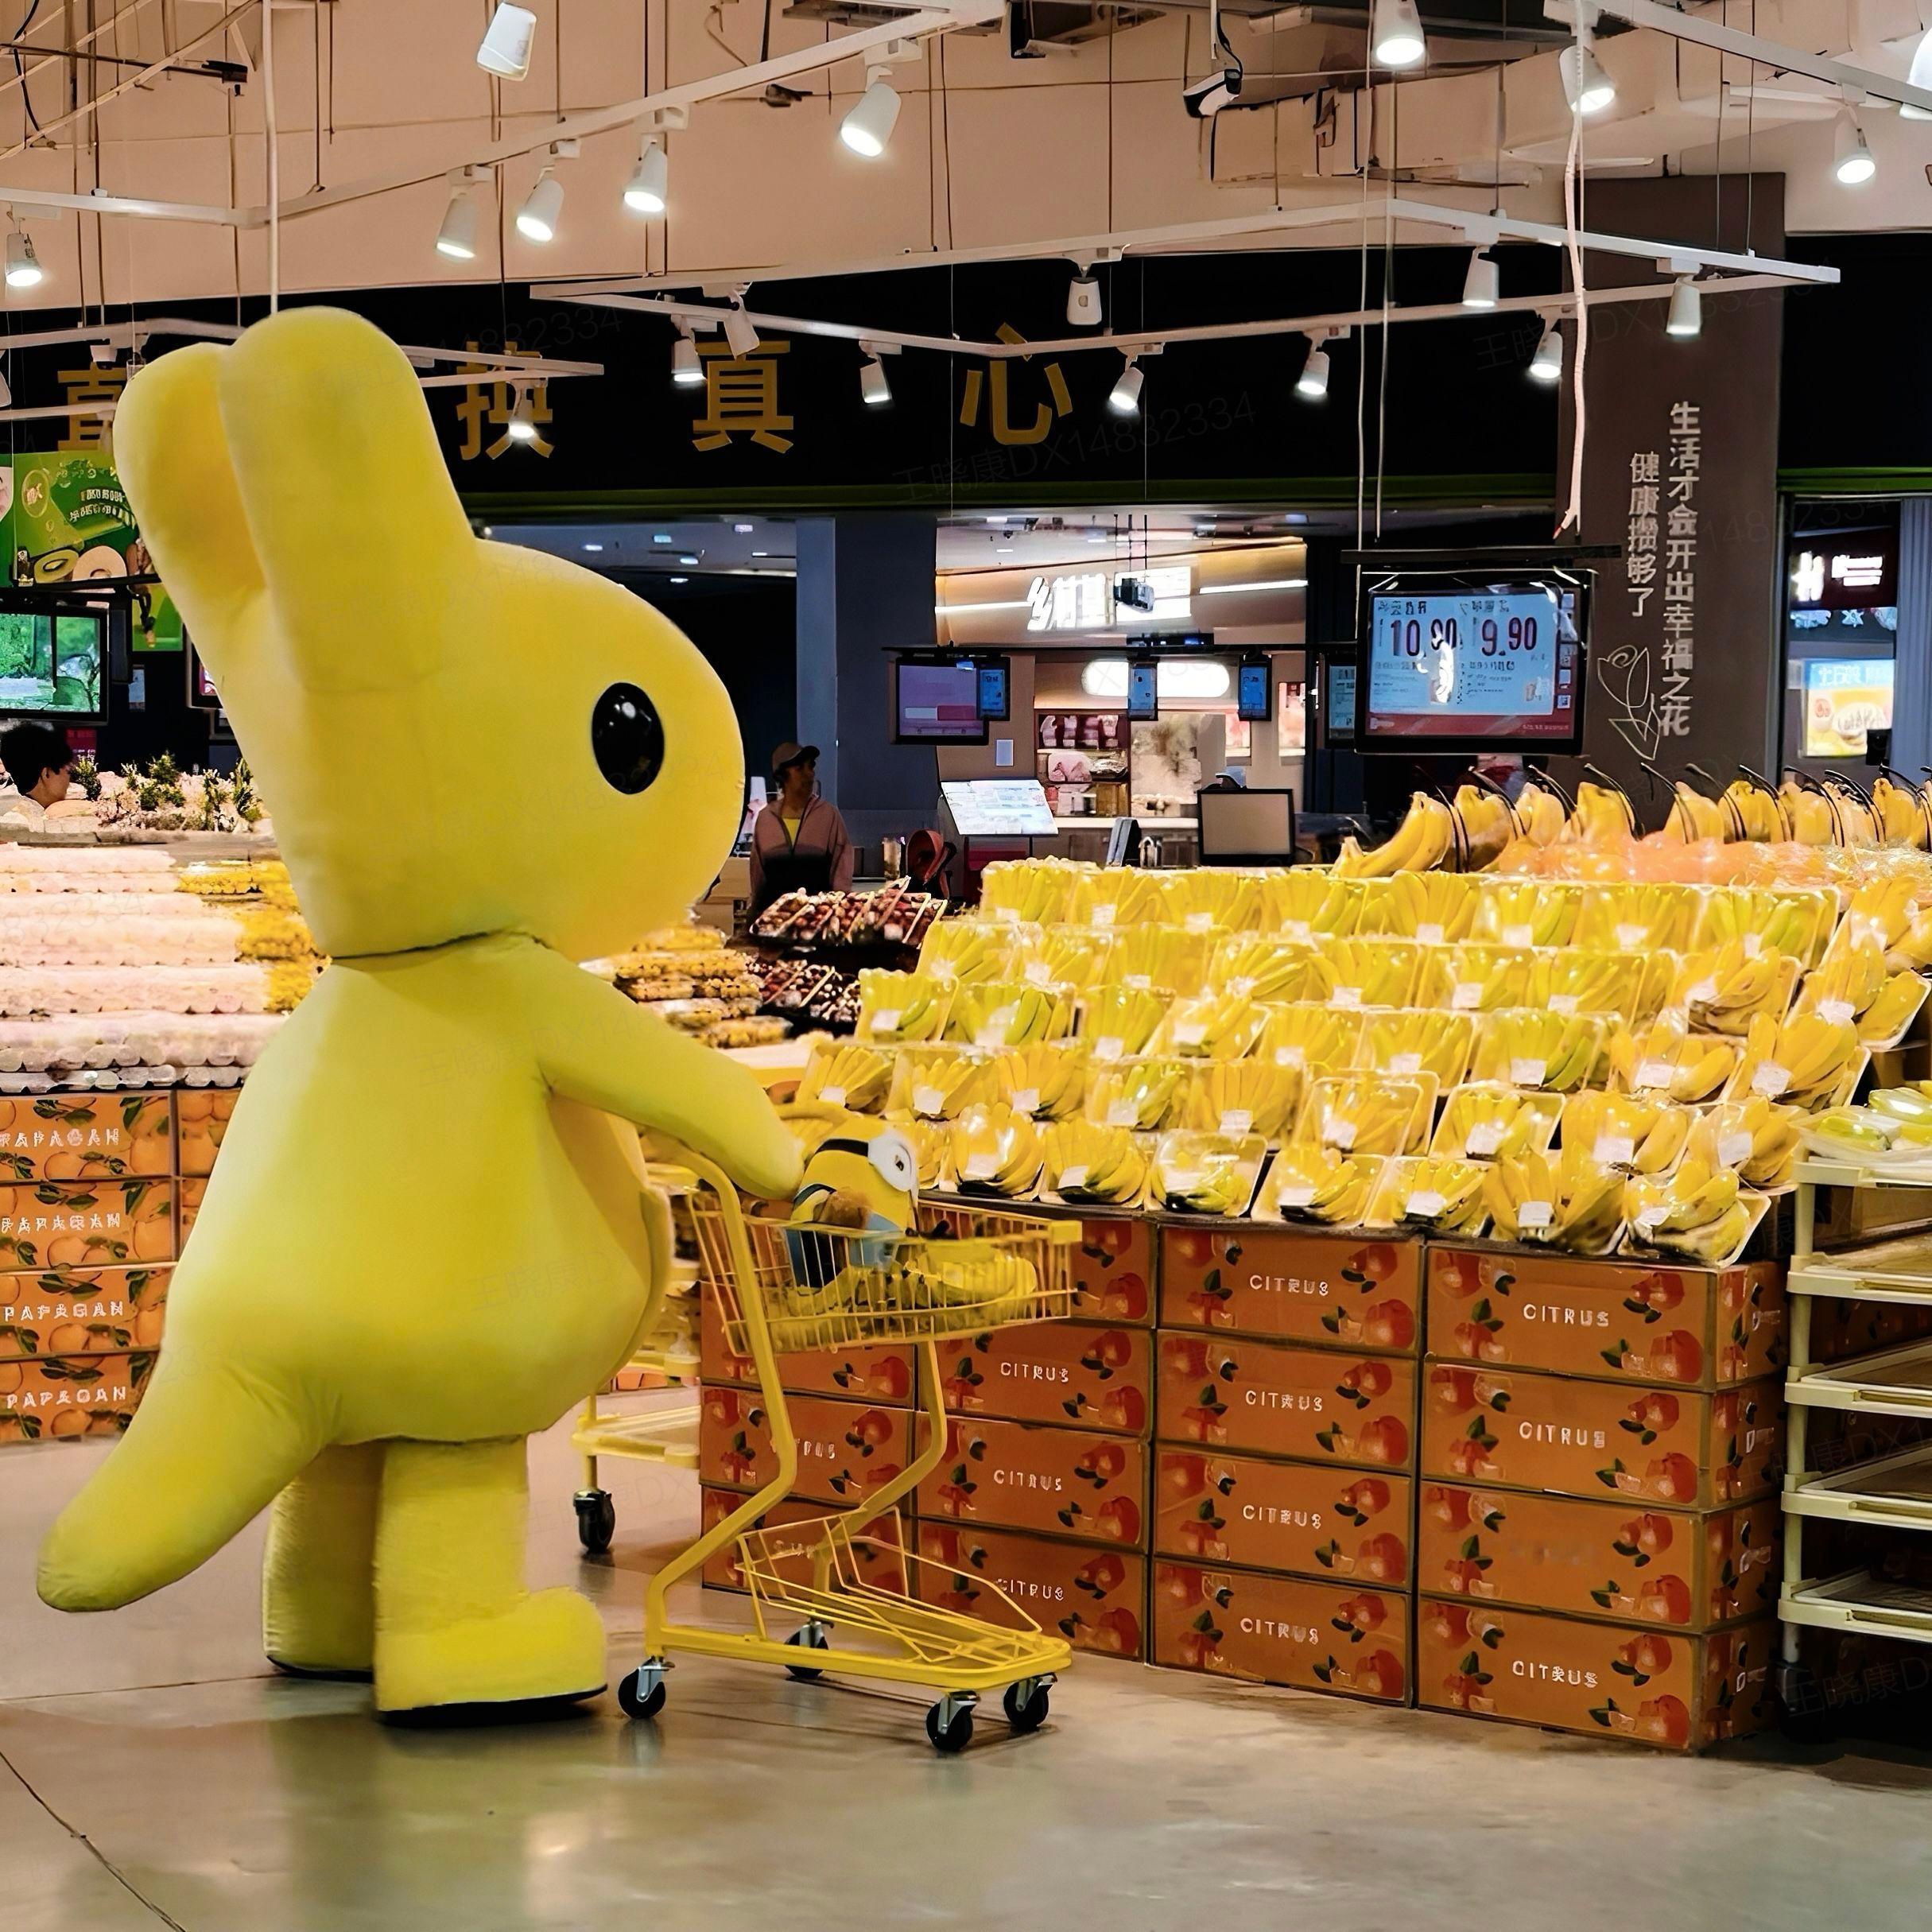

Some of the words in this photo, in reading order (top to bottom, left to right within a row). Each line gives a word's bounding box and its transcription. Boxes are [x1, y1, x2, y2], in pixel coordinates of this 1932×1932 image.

[1481, 615, 1538, 658] 9.90
[1523, 1303, 1609, 1327] CITRUS
[1000, 1362, 1069, 1383] CITRUS
